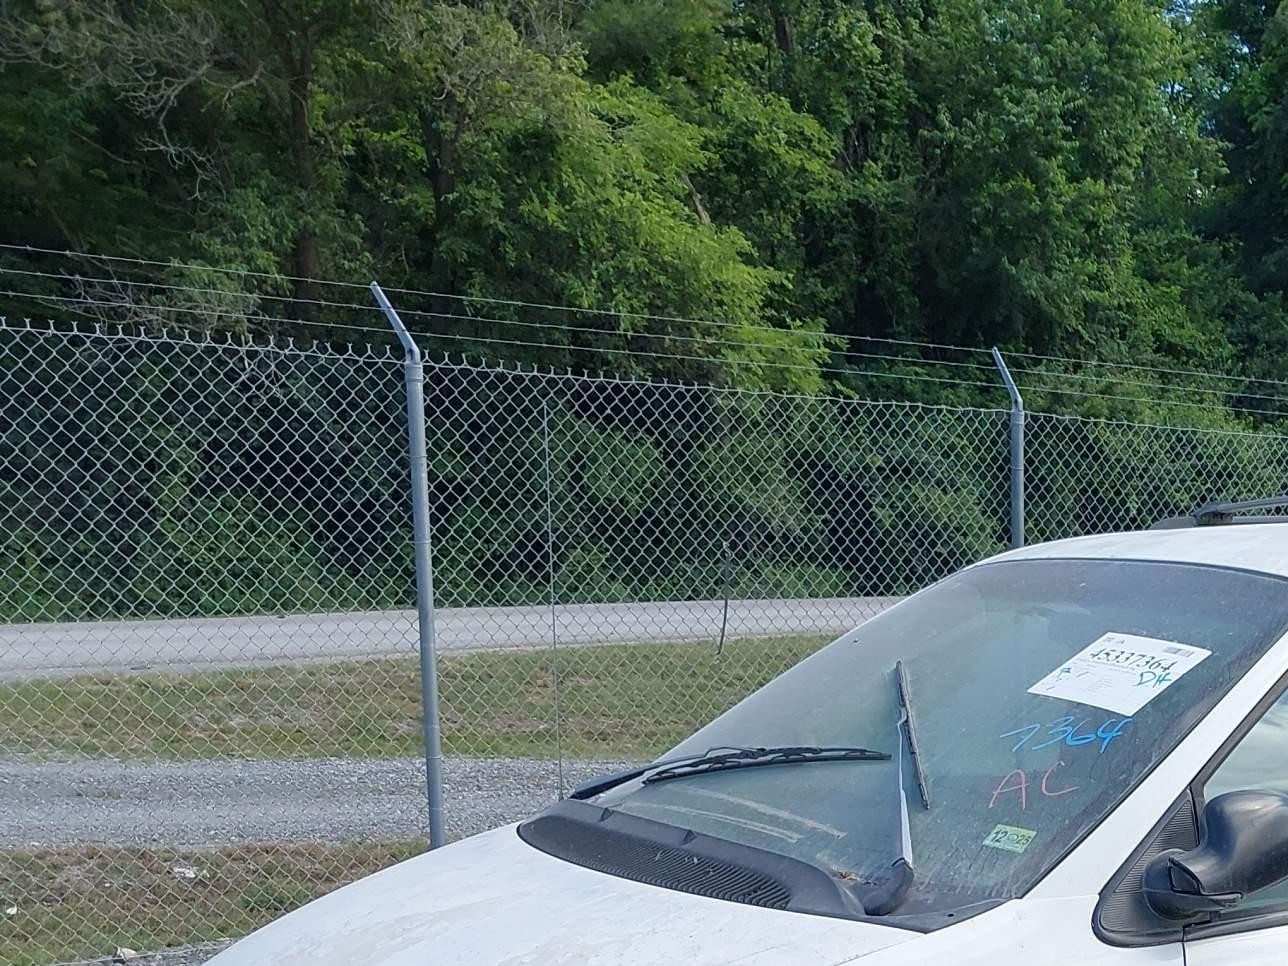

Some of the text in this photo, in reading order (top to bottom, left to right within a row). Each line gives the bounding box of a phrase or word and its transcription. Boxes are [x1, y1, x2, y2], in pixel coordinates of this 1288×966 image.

[1089, 648, 1178, 673] 45337364
[1000, 716, 1133, 753] 7364
[991, 829, 1009, 843] 12
